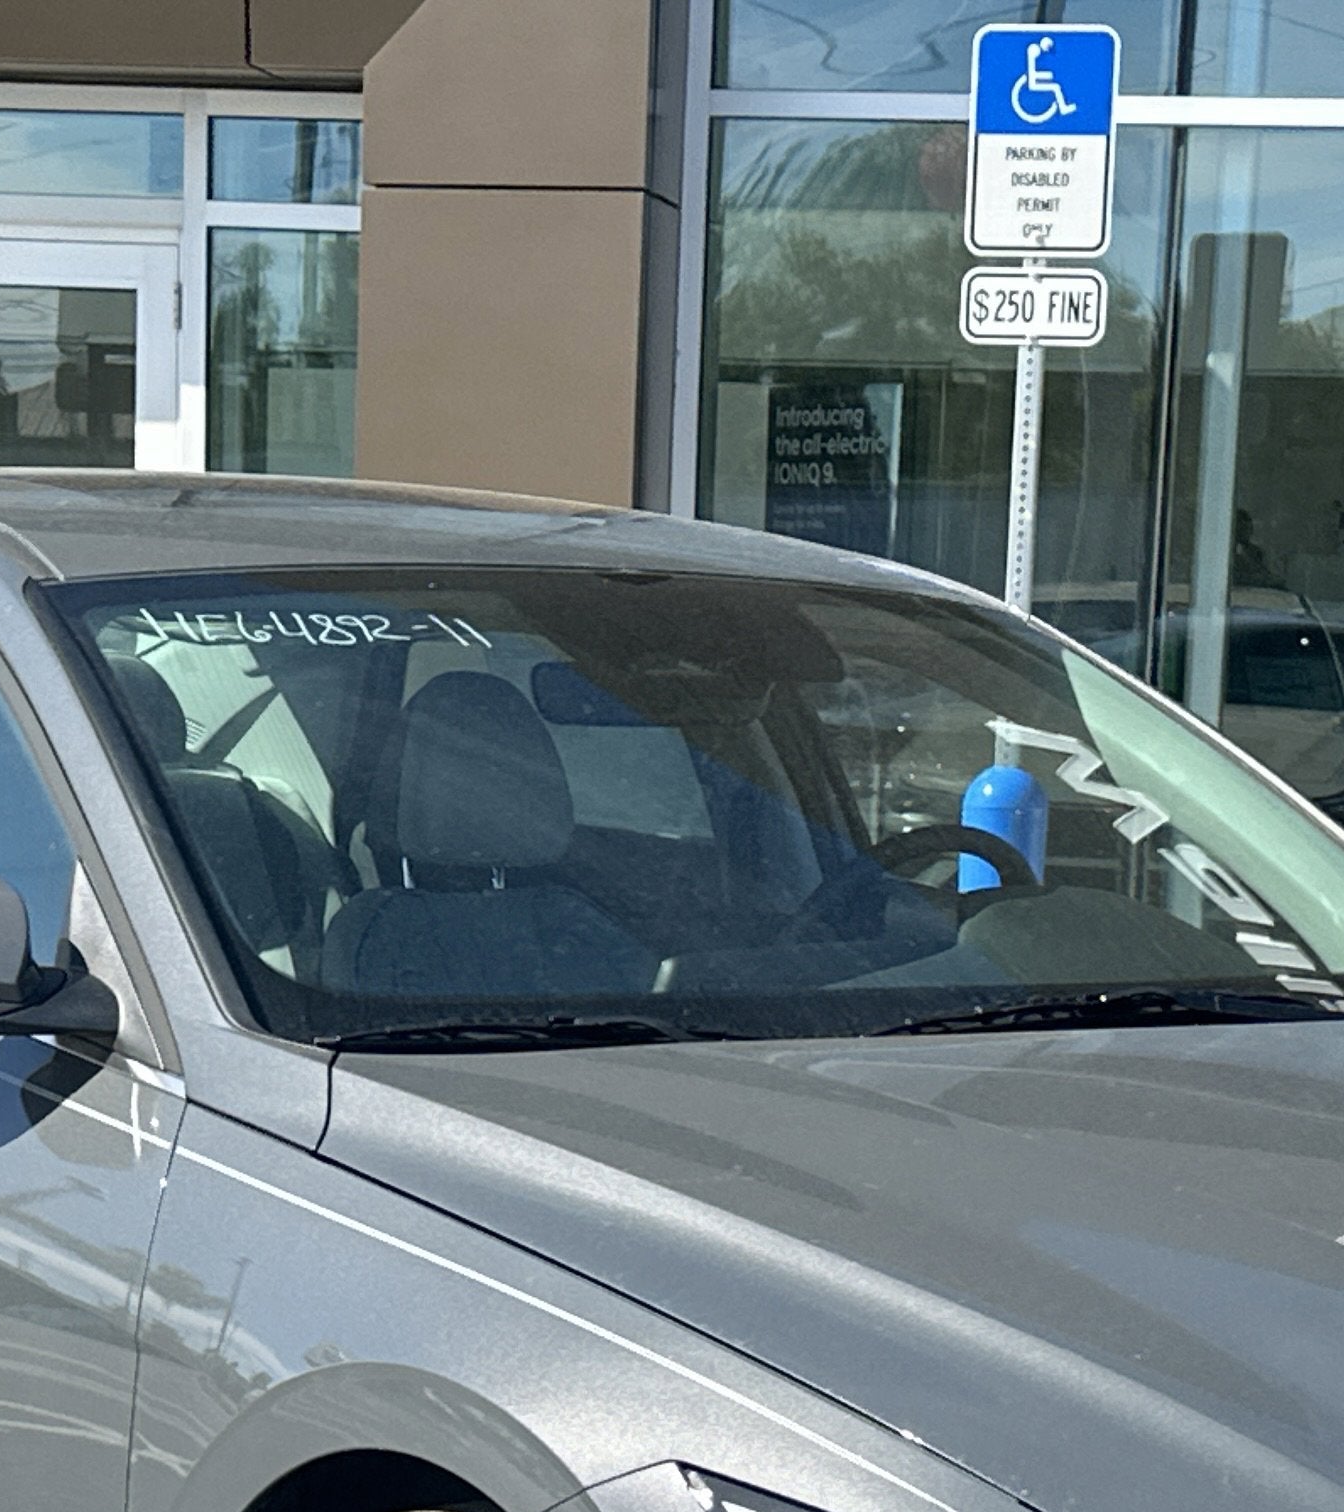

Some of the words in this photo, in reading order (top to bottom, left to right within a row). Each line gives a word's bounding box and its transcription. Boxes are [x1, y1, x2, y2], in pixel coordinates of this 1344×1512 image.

[1005, 146, 1056, 161] PARKING
[1061, 148, 1077, 161] BY
[1011, 172, 1070, 187] DISABLED
[1016, 197, 1061, 212] PERMIT
[973, 288, 1035, 326] $250
[1048, 291, 1094, 324] FINE
[775, 402, 865, 431] Introducing
[775, 433, 801, 456] the
[775, 462, 821, 487] IONIQ
